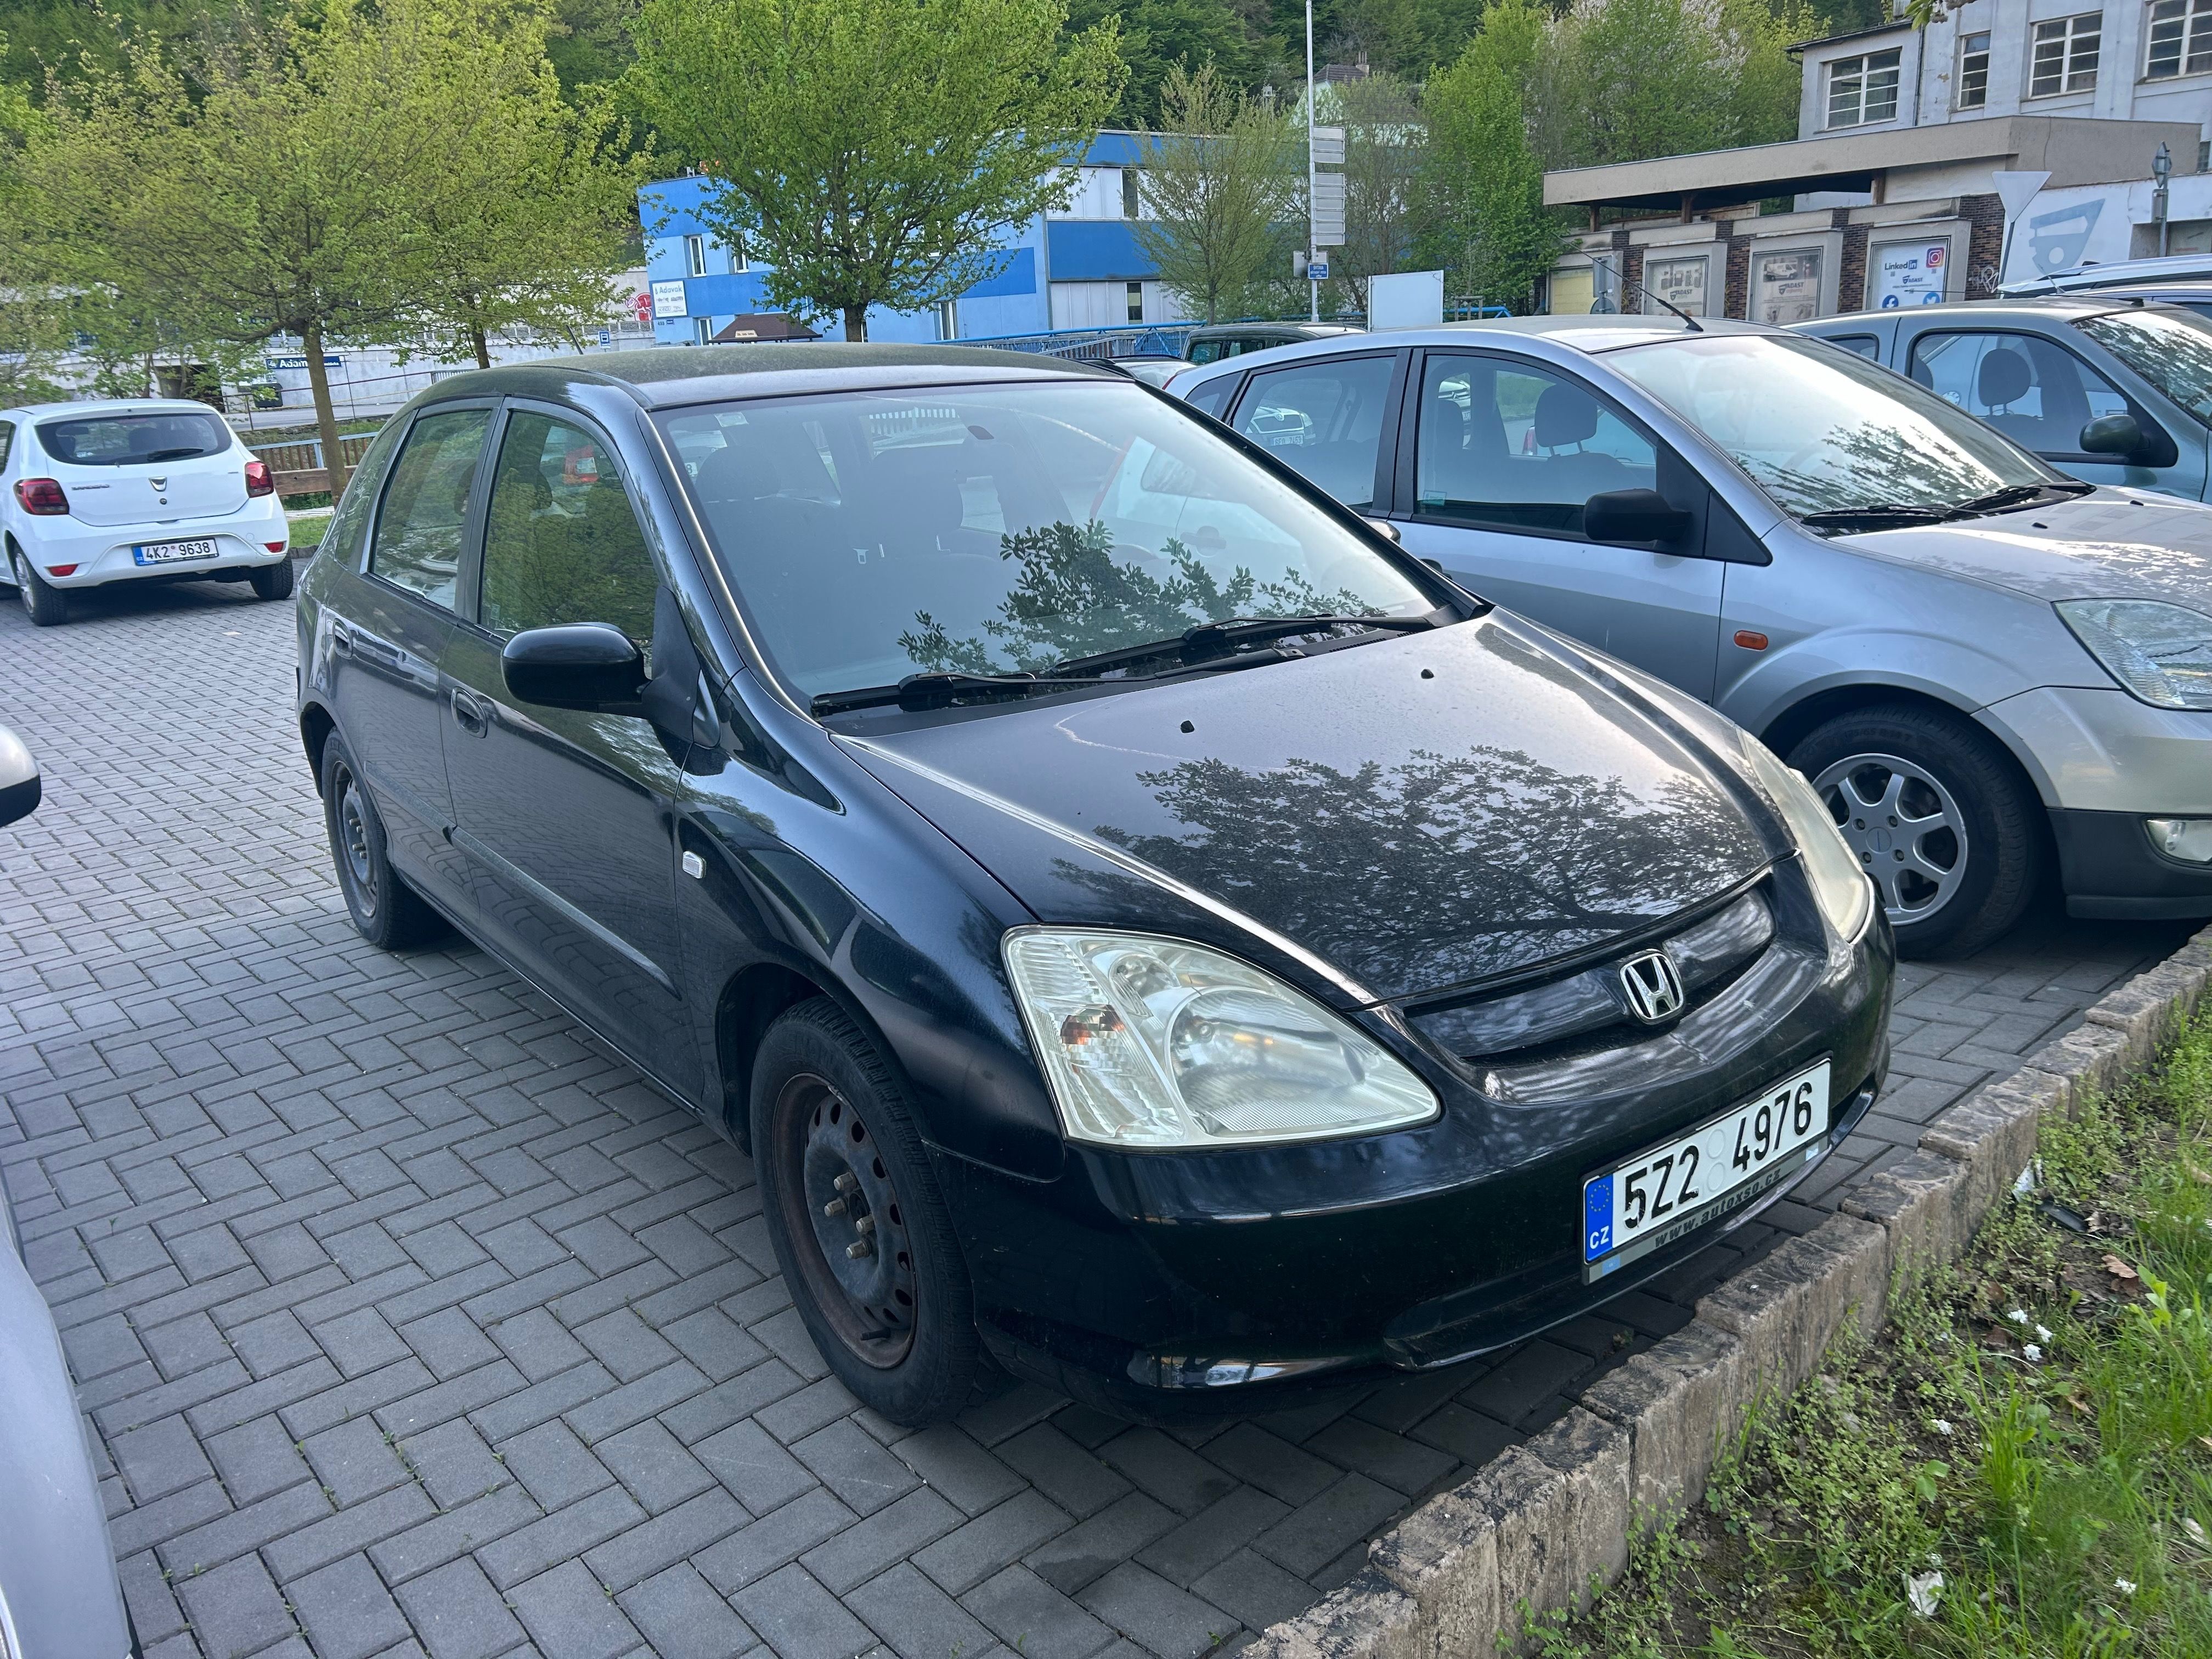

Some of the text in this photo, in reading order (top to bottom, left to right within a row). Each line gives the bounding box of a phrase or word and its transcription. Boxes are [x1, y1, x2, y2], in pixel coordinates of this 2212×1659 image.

[659, 285, 682, 294] Adavak
[146, 546, 170, 559] 4K2
[179, 542, 211, 556] 9638
[1623, 1081, 1813, 1229] 5Z2 4976
[1655, 1168, 1781, 1248] www.autoxso.cz
[1589, 1226, 1610, 1249] CZ
